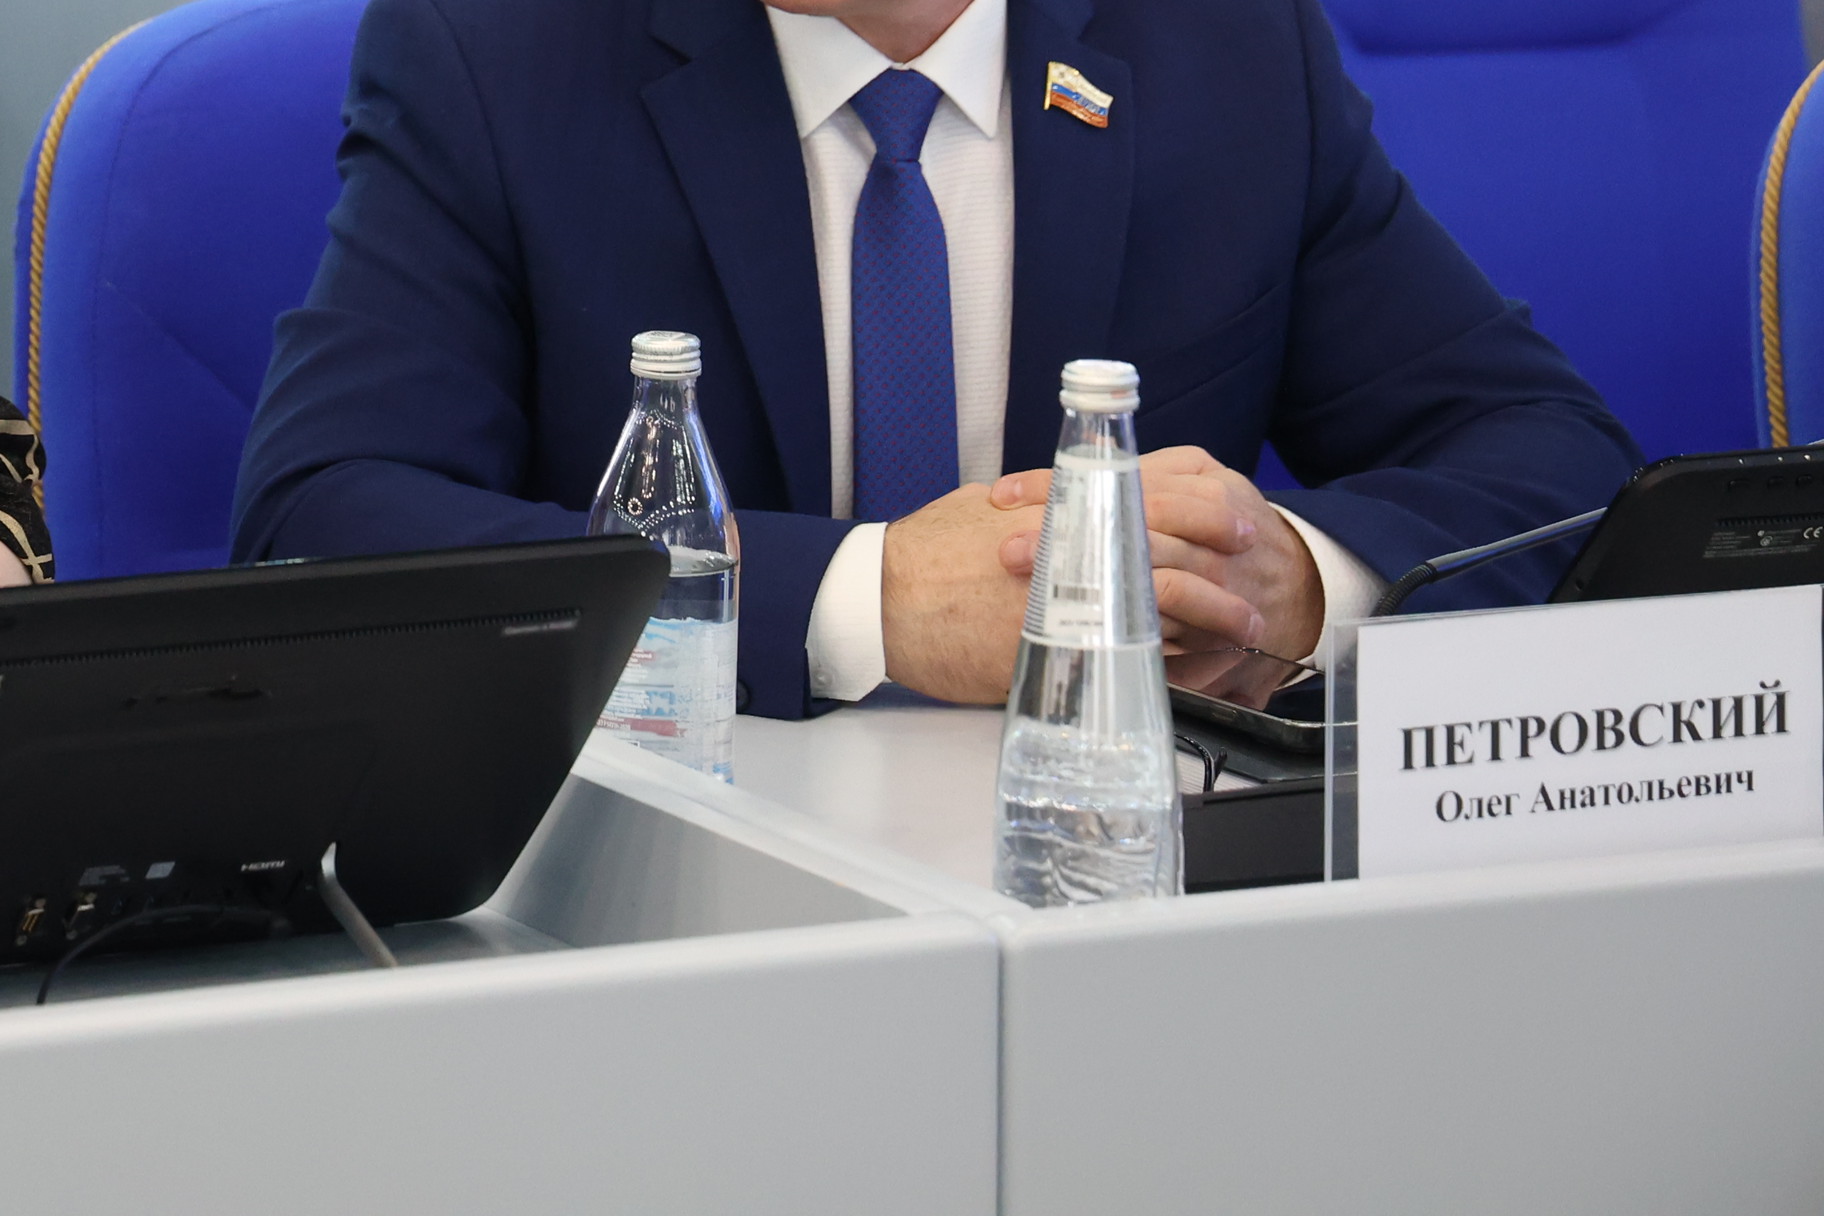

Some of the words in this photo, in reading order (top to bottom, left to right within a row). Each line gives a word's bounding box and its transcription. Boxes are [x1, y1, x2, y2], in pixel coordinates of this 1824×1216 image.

[1399, 678, 1791, 772] ПЕТРОВСКИЙ
[1434, 789, 1521, 824] Олег
[1529, 768, 1756, 816] Анатольевич
